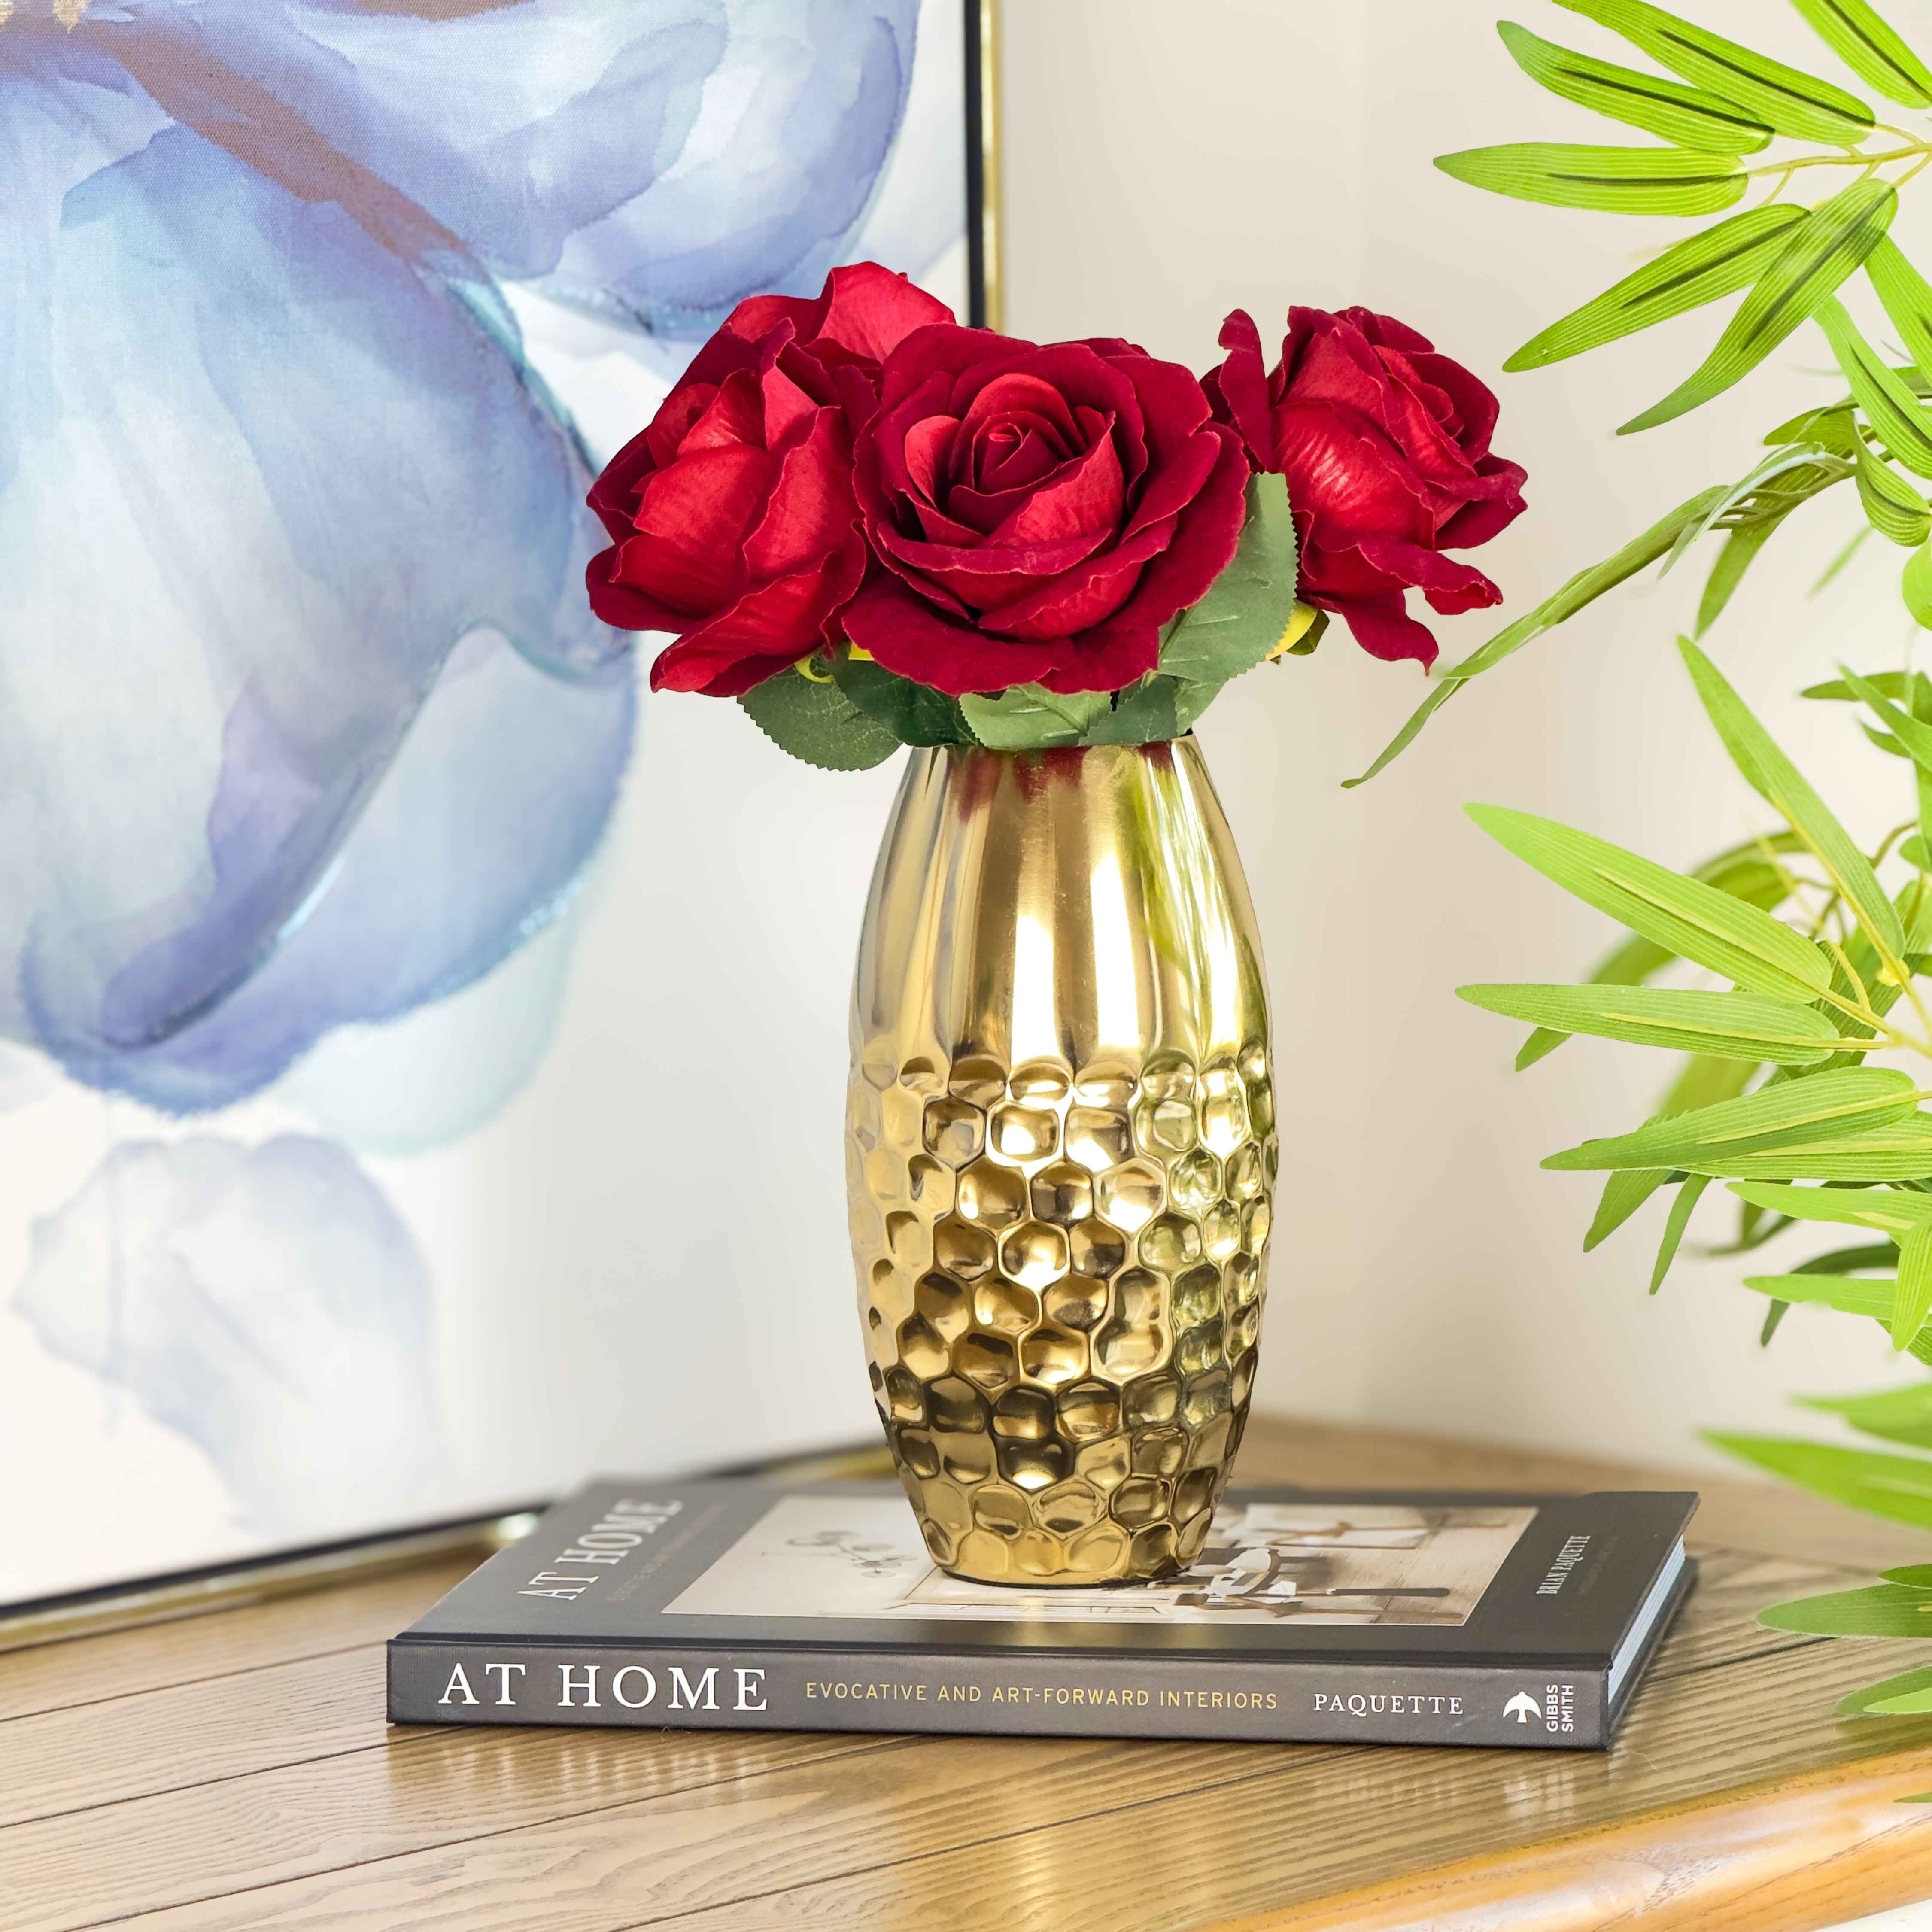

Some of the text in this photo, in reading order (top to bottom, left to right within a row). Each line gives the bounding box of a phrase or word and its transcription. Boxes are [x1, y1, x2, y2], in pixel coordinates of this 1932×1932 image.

[554, 1498, 683, 1565] HOME
[518, 1571, 600, 1600] AT
[1536, 1535, 1591, 1594] BRIAN PAQUETTE
[437, 1663, 767, 1710] AT HOME
[806, 1682, 1277, 1709] EVOCATIVE AND ART-FORWARD INTERIORS
[1314, 1693, 1463, 1717] PAQUETTE
[1546, 1684, 1559, 1732] GIBBS
[1561, 1685, 1574, 1732] SMITH
